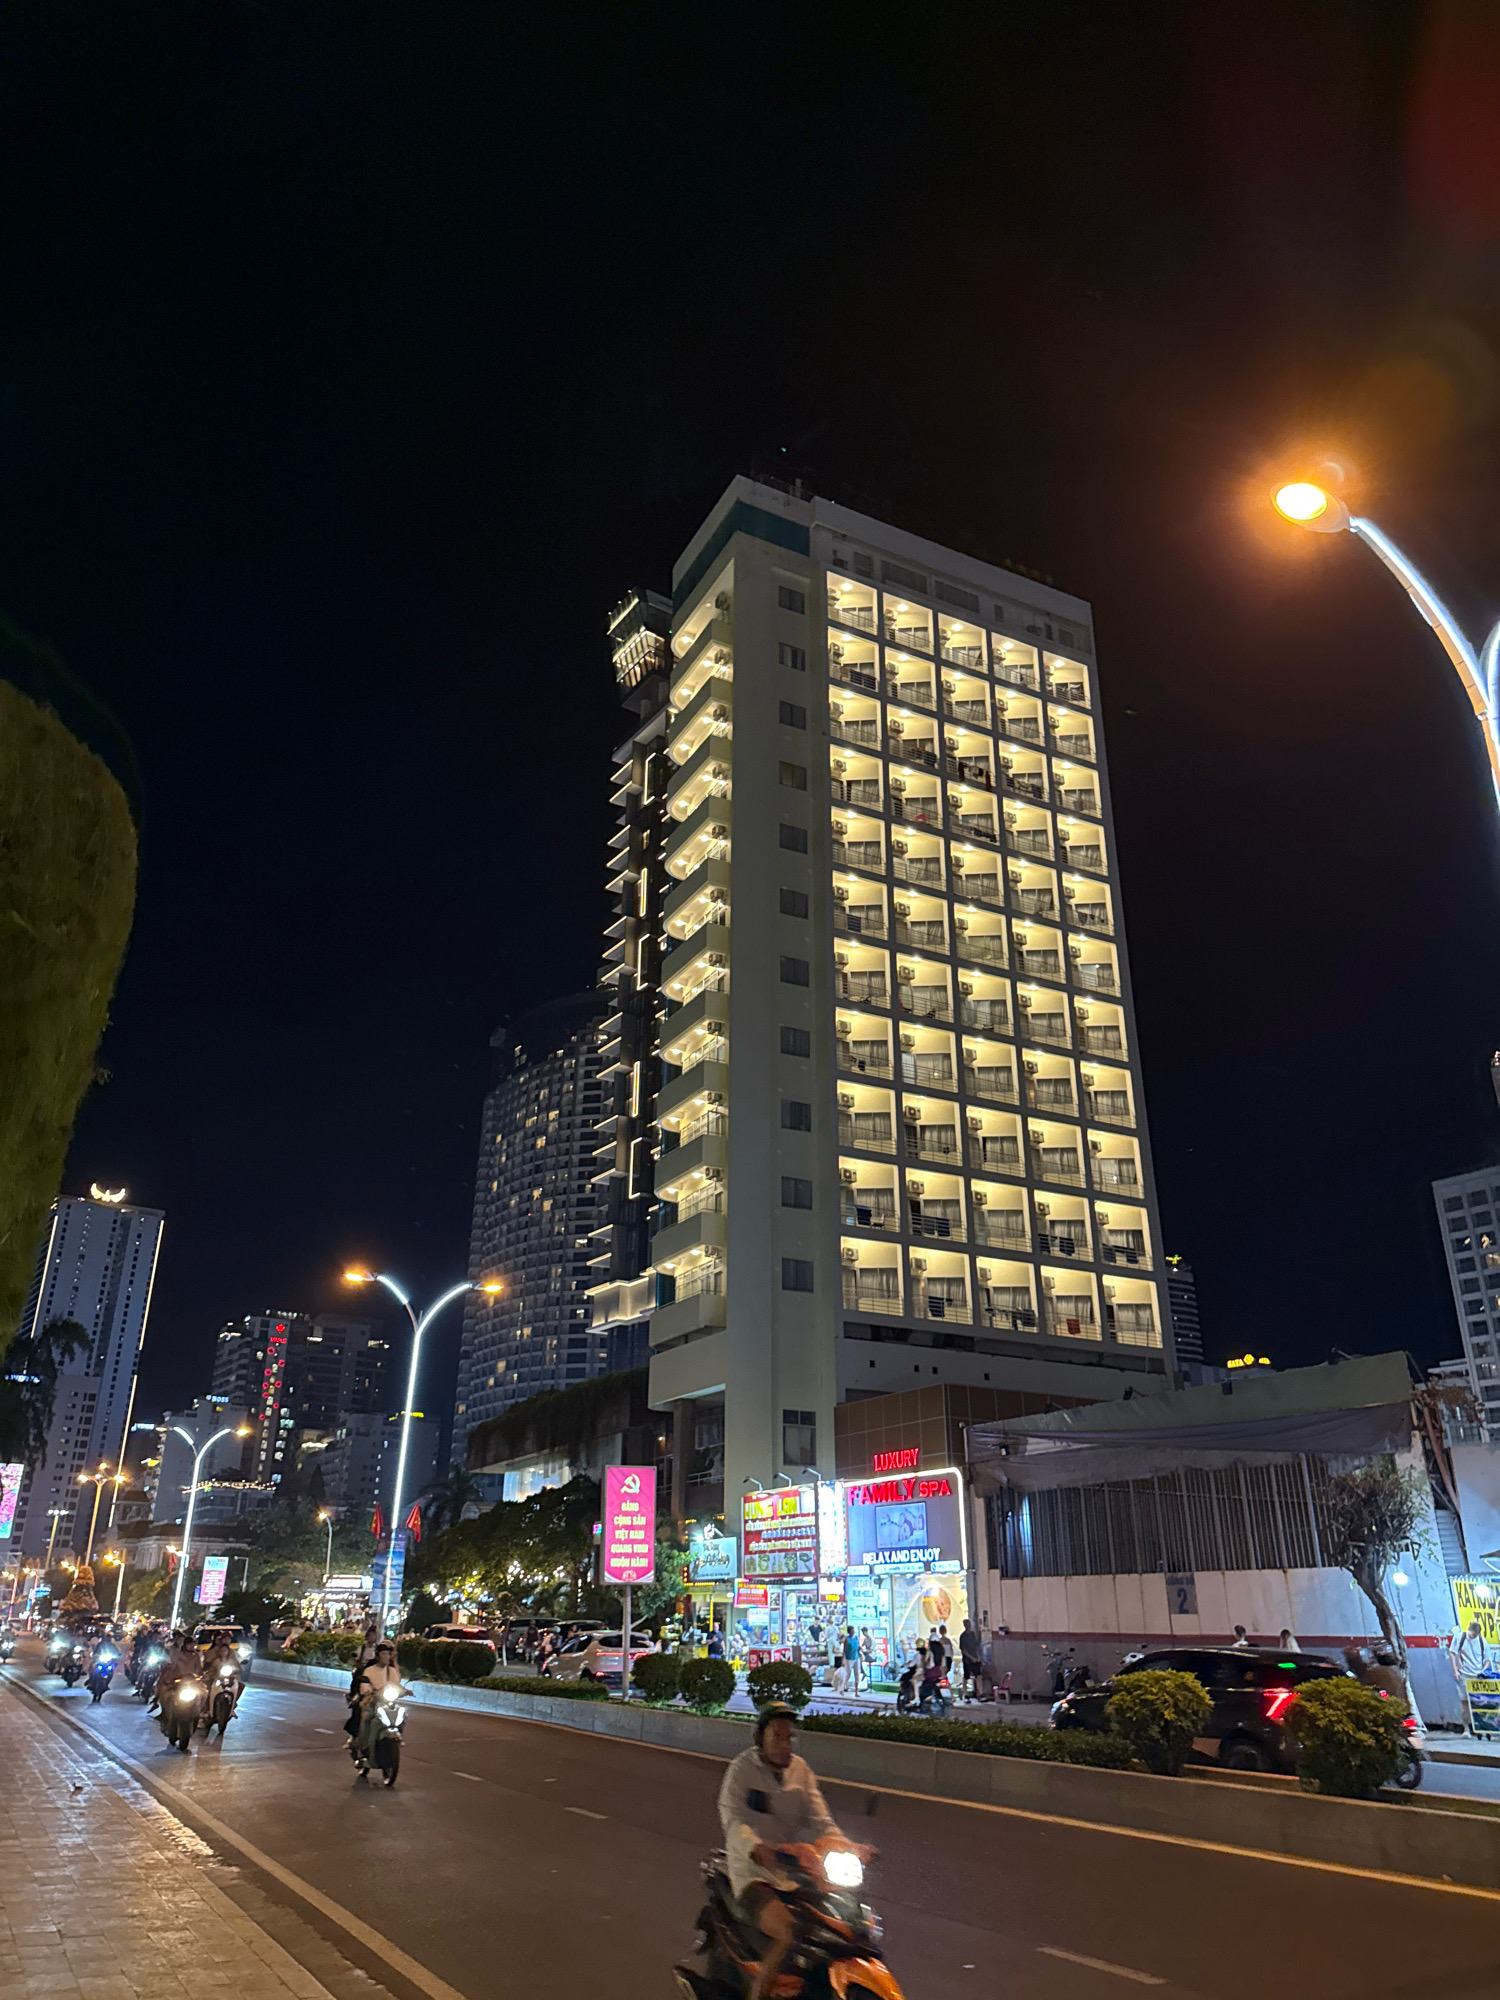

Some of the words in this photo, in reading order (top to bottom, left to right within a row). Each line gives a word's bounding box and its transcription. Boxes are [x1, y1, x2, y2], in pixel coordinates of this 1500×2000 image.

[874, 1448, 919, 1472] LUXURY
[848, 1478, 916, 1506] FAMILY
[919, 1479, 951, 1498] SPA
[777, 1496, 800, 1516] LAN
[614, 1528, 629, 1541] VIỆT
[863, 1550, 891, 1564] RELAX
[891, 1550, 910, 1562] AND
[910, 1548, 940, 1561] ENJOY
[1177, 1588, 1190, 1614] 2
